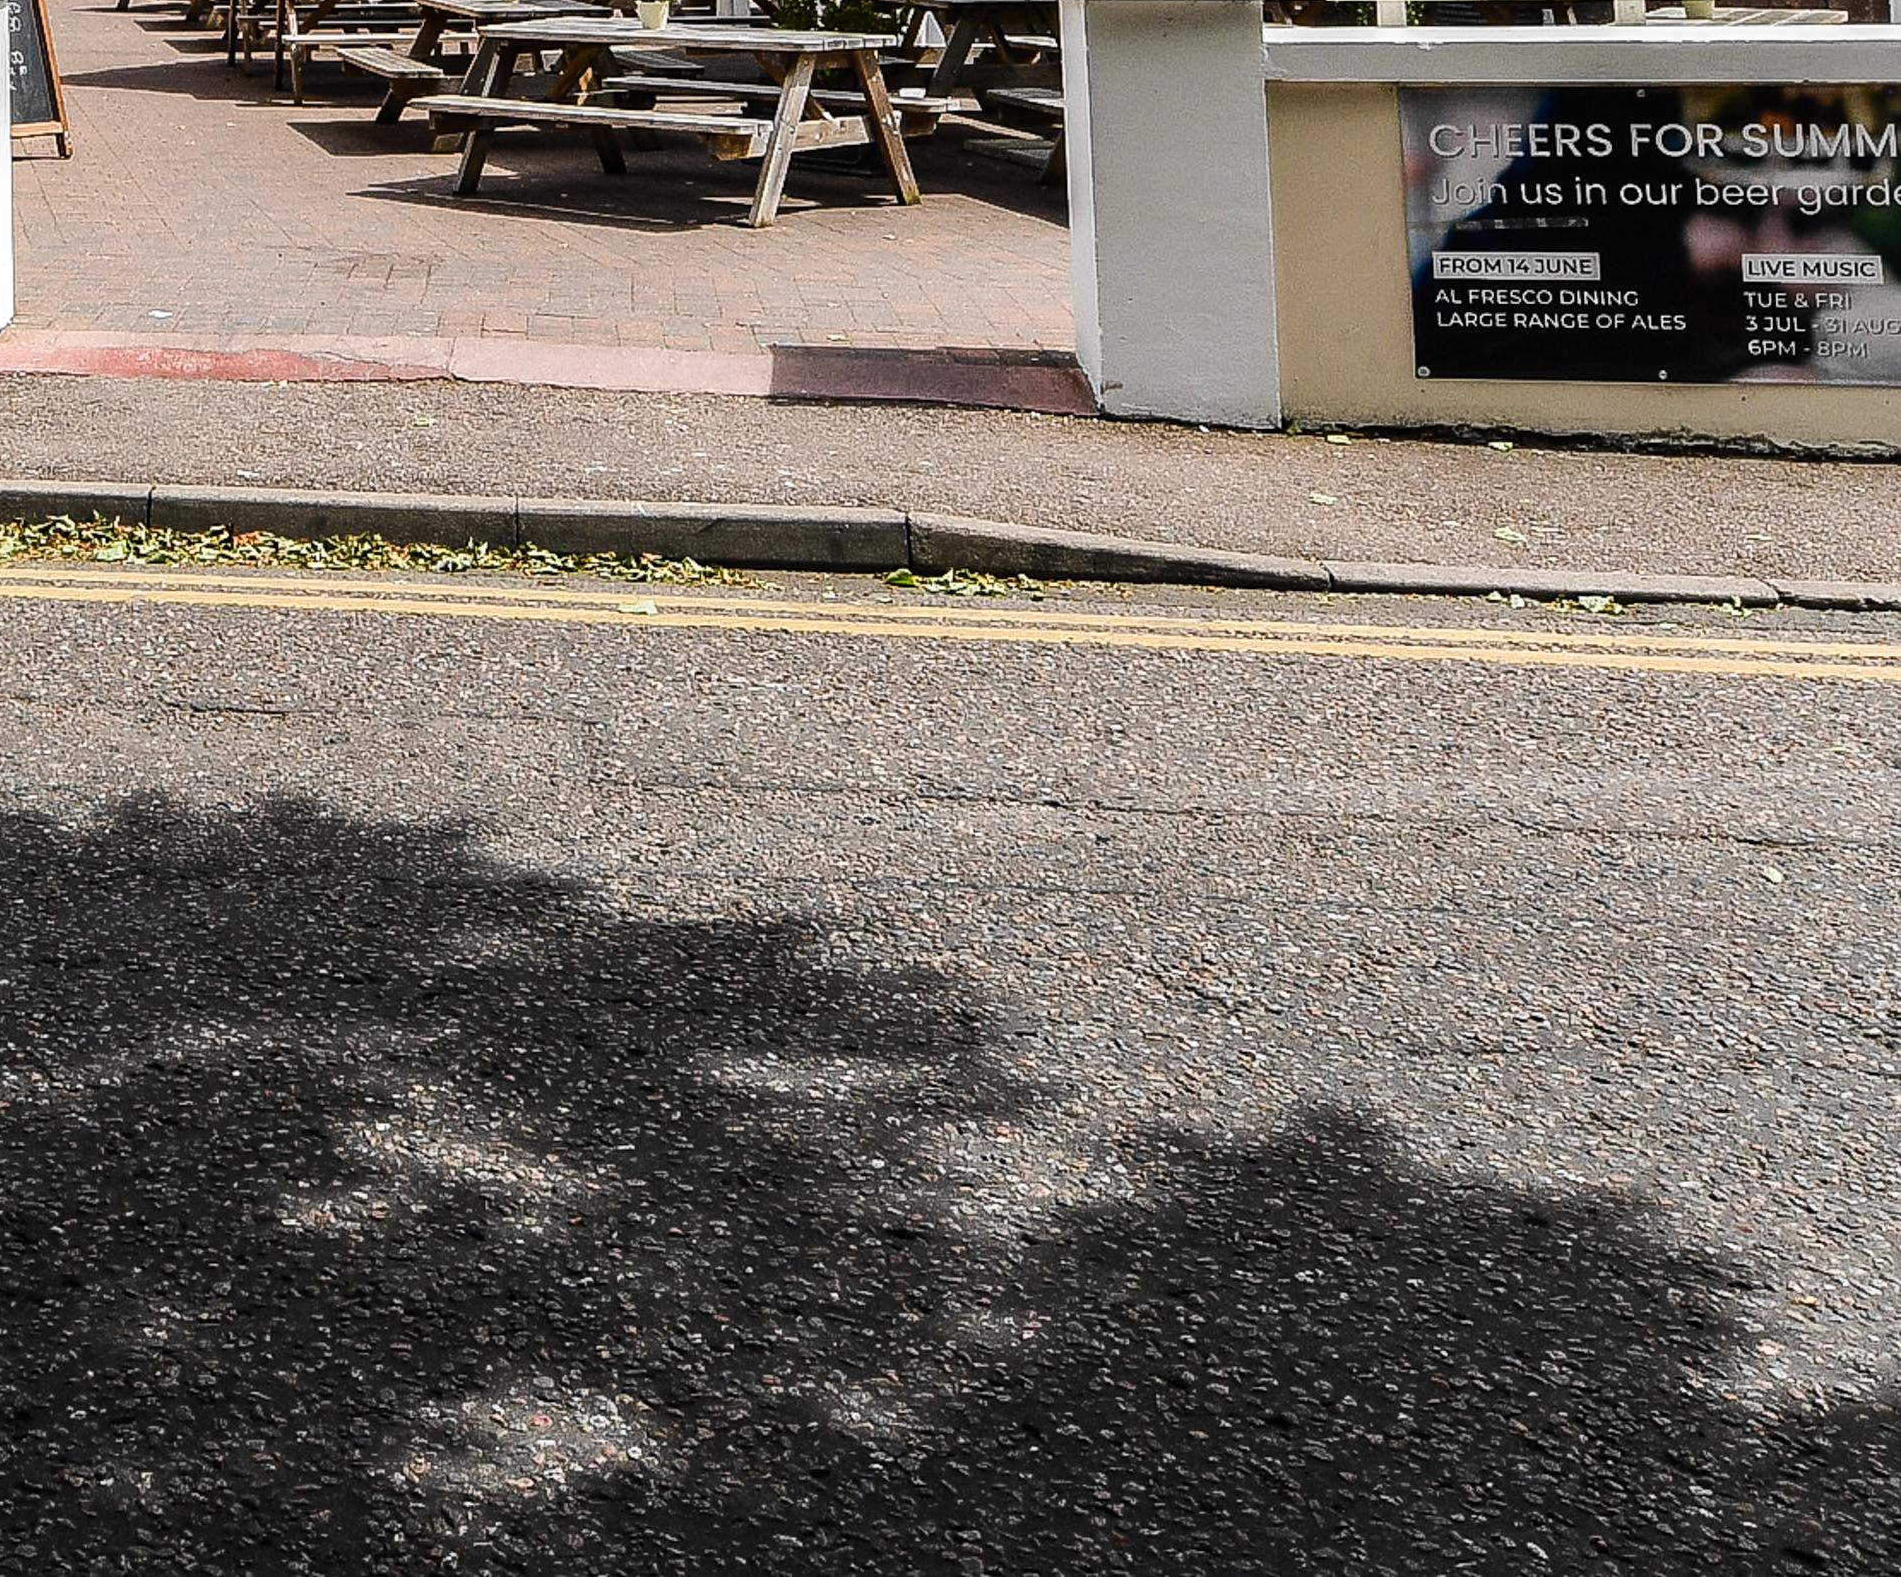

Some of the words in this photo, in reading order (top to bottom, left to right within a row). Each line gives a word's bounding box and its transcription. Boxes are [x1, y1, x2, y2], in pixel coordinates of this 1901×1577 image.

[1428, 123, 1613, 158] CHEERS
[1629, 123, 1724, 158] FOR
[1741, 123, 1899, 158] SUMM
[1431, 177, 1508, 205] Join
[1520, 183, 1564, 206] us
[1574, 176, 1607, 206] in
[1619, 183, 1683, 206] our
[1695, 177, 1784, 206] beer
[1438, 258, 1502, 274] FROM
[1507, 258, 1531, 274] 14
[1535, 258, 1593, 275] JUNE
[1748, 260, 1796, 277] LIVE
[1802, 261, 1876, 278] MUSIC
[1435, 289, 1463, 305] AL
[1468, 289, 1553, 305] FRESCO
[1559, 290, 1639, 307] DINING
[1743, 291, 1788, 308] TUE
[1793, 292, 1810, 309] &
[1814, 292, 1852, 310] FRI
[1436, 312, 1507, 328] LARGE
[1513, 312, 1590, 329] RANGE
[1595, 313, 1625, 329] OF
[1631, 314, 1687, 331] ALES
[1745, 315, 1758, 332] 3
[1762, 316, 1807, 333] JUL
[1824, 316, 1848, 334] 31
[1748, 339, 1796, 357] 6PM
[1816, 340, 1870, 359] 8PM
